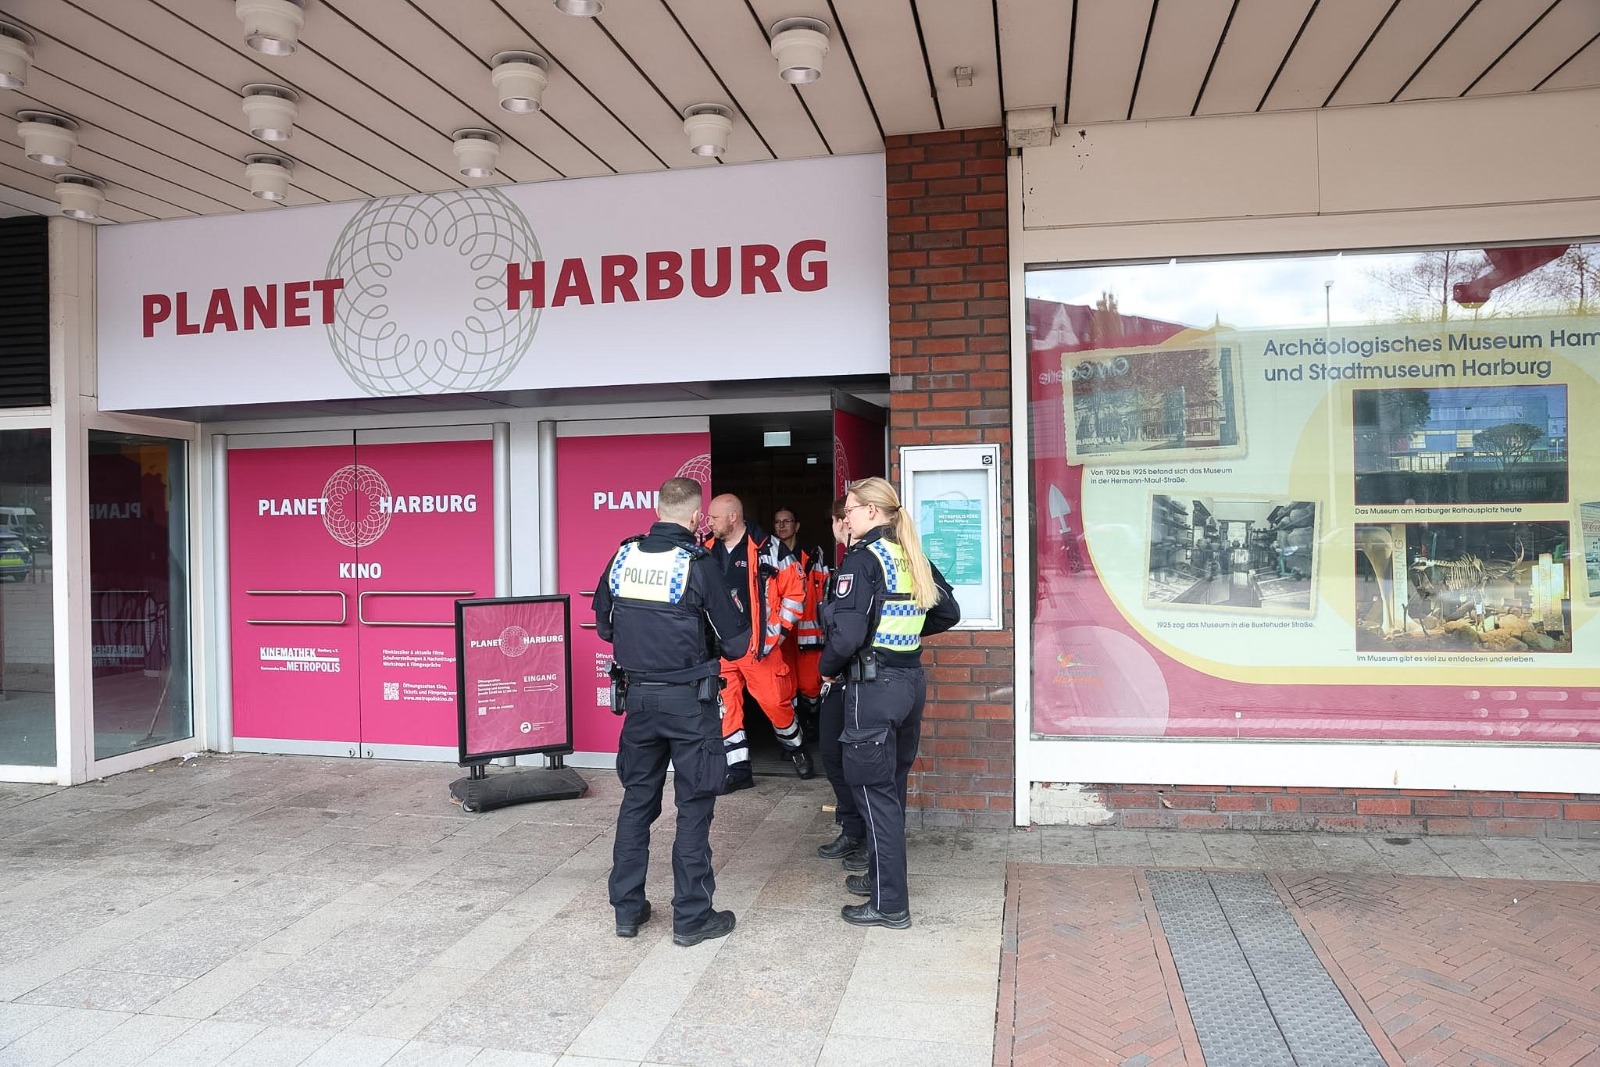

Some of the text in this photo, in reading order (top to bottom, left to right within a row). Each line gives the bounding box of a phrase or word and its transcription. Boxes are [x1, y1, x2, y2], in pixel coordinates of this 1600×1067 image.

[142, 239, 829, 339] PLANET HARBURG
[1263, 334, 1443, 358] Archäologisches
[1448, 331, 1543, 351] Museum
[1264, 358, 1552, 382] und Stadtmuseum Harburg
[258, 494, 477, 516] PLANET HARBURG
[338, 562, 383, 579] KINO
[623, 566, 669, 587] POLIZEI
[470, 635, 564, 648] PLANET HARBURG
[260, 646, 316, 658] KINEMATHEK
[1399, 655, 1413, 663] gibt
[286, 661, 341, 673] METROPOLIS
[523, 673, 557, 683] EINGANG
